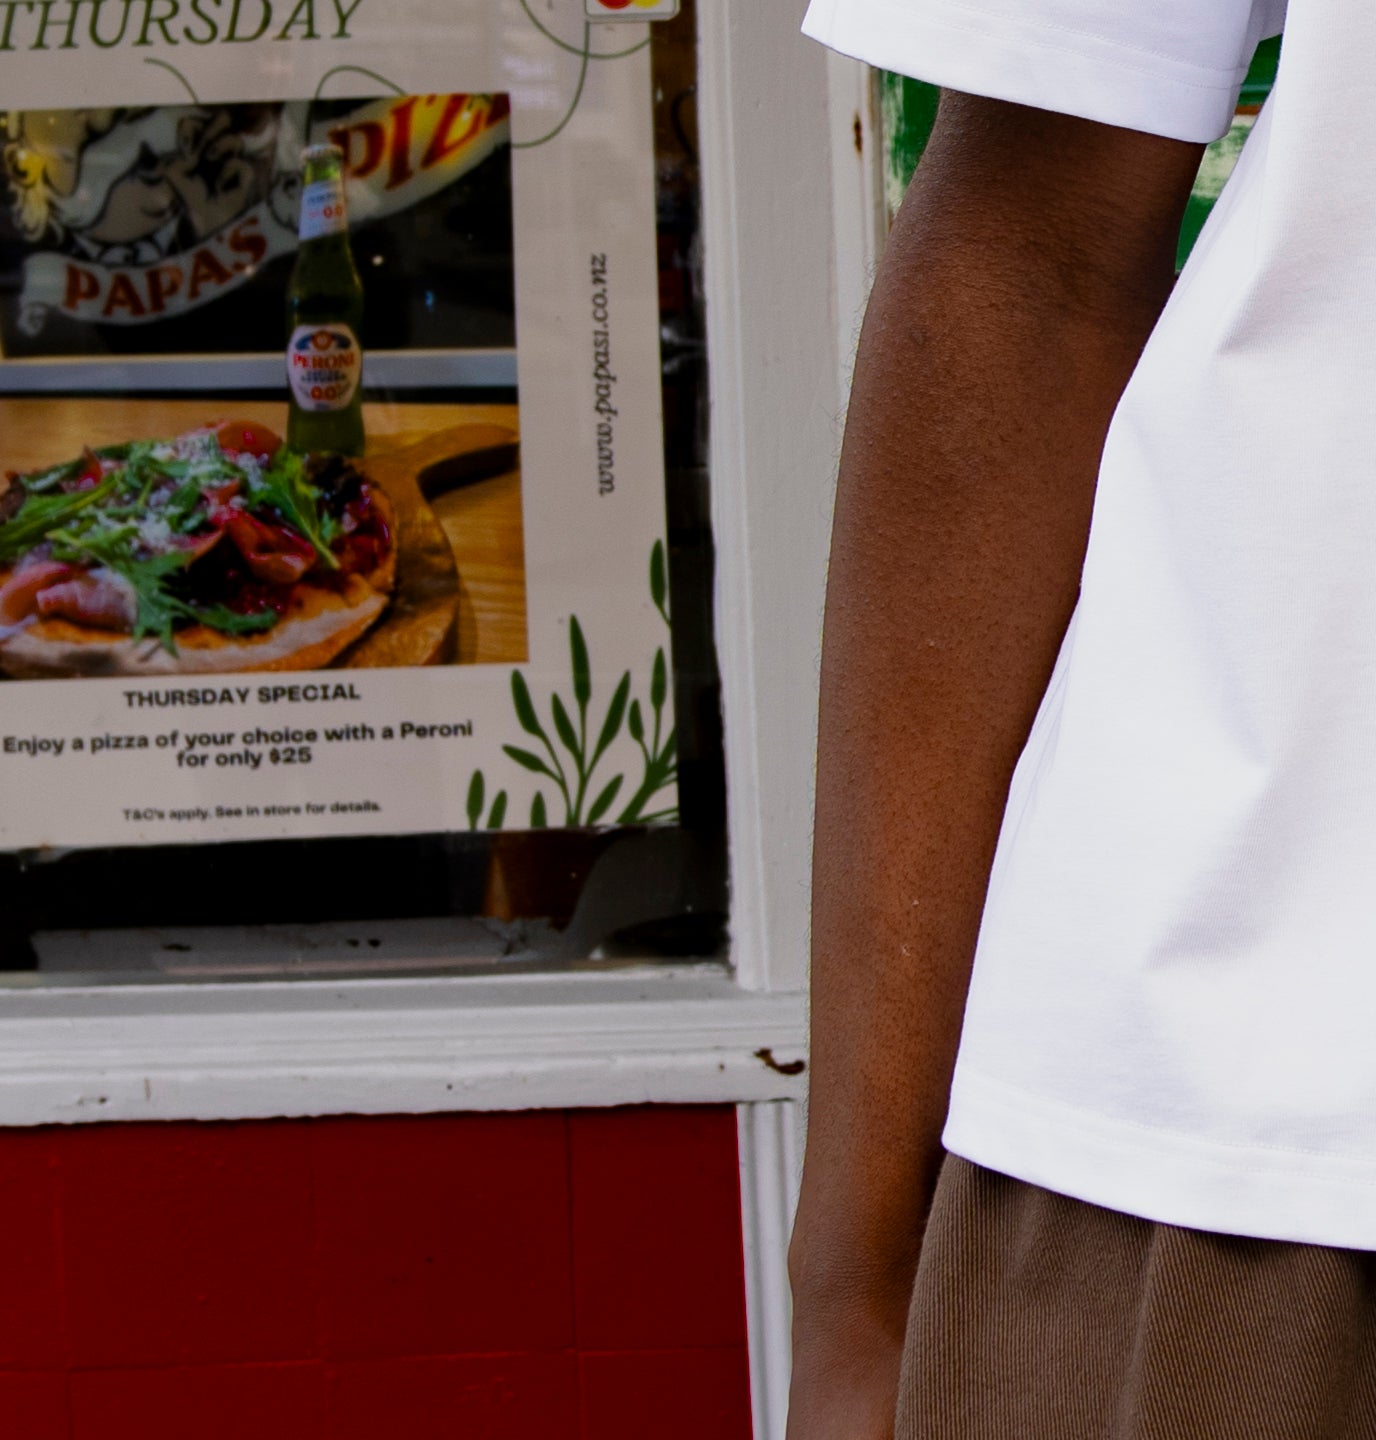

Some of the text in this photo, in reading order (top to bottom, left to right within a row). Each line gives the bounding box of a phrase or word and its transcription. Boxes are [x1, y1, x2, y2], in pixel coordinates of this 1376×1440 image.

[62, 217, 268, 318] PAPA'S
[293, 352, 355, 369] PERONI
[591, 253, 617, 496] www.papasi.co.nz
[123, 683, 360, 708] THURSDAY SPECIAL
[3, 720, 473, 756] Enjoy a pizza of your choice with a Peroni
[176, 747, 312, 769] for only $25
[123, 800, 381, 822] T&C's apply. See in store for details.
